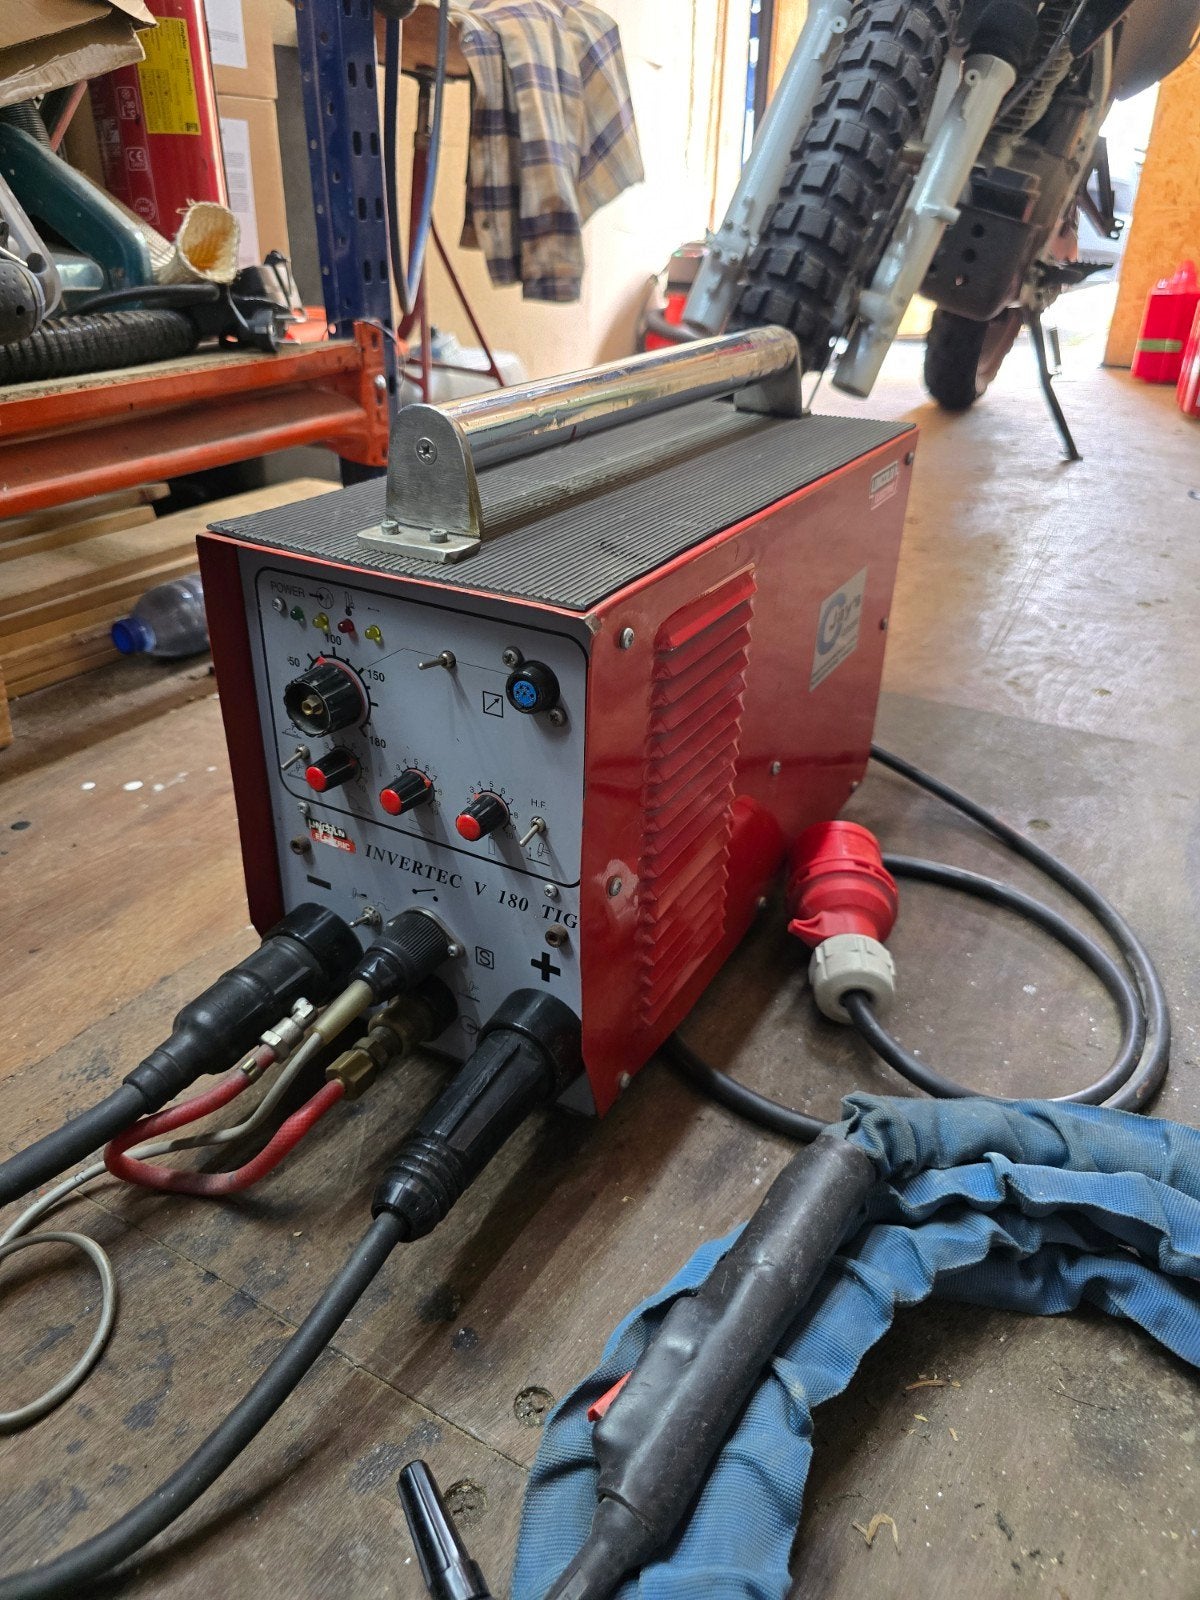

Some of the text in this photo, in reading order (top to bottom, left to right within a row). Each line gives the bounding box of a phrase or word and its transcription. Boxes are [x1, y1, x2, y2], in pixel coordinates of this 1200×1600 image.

[269, 580, 306, 598] POWER
[324, 632, 342, 646] 100
[287, 656, 301, 668] 50
[367, 669, 385, 683] 150
[368, 736, 387, 749] 180
[413, 757, 420, 765] 5
[469, 785, 475, 793] 3
[488, 780, 494, 788] 5
[500, 787, 506, 795] 6
[513, 811, 519, 819] 8
[365, 844, 579, 929] INVERTEC V 180 TIG
